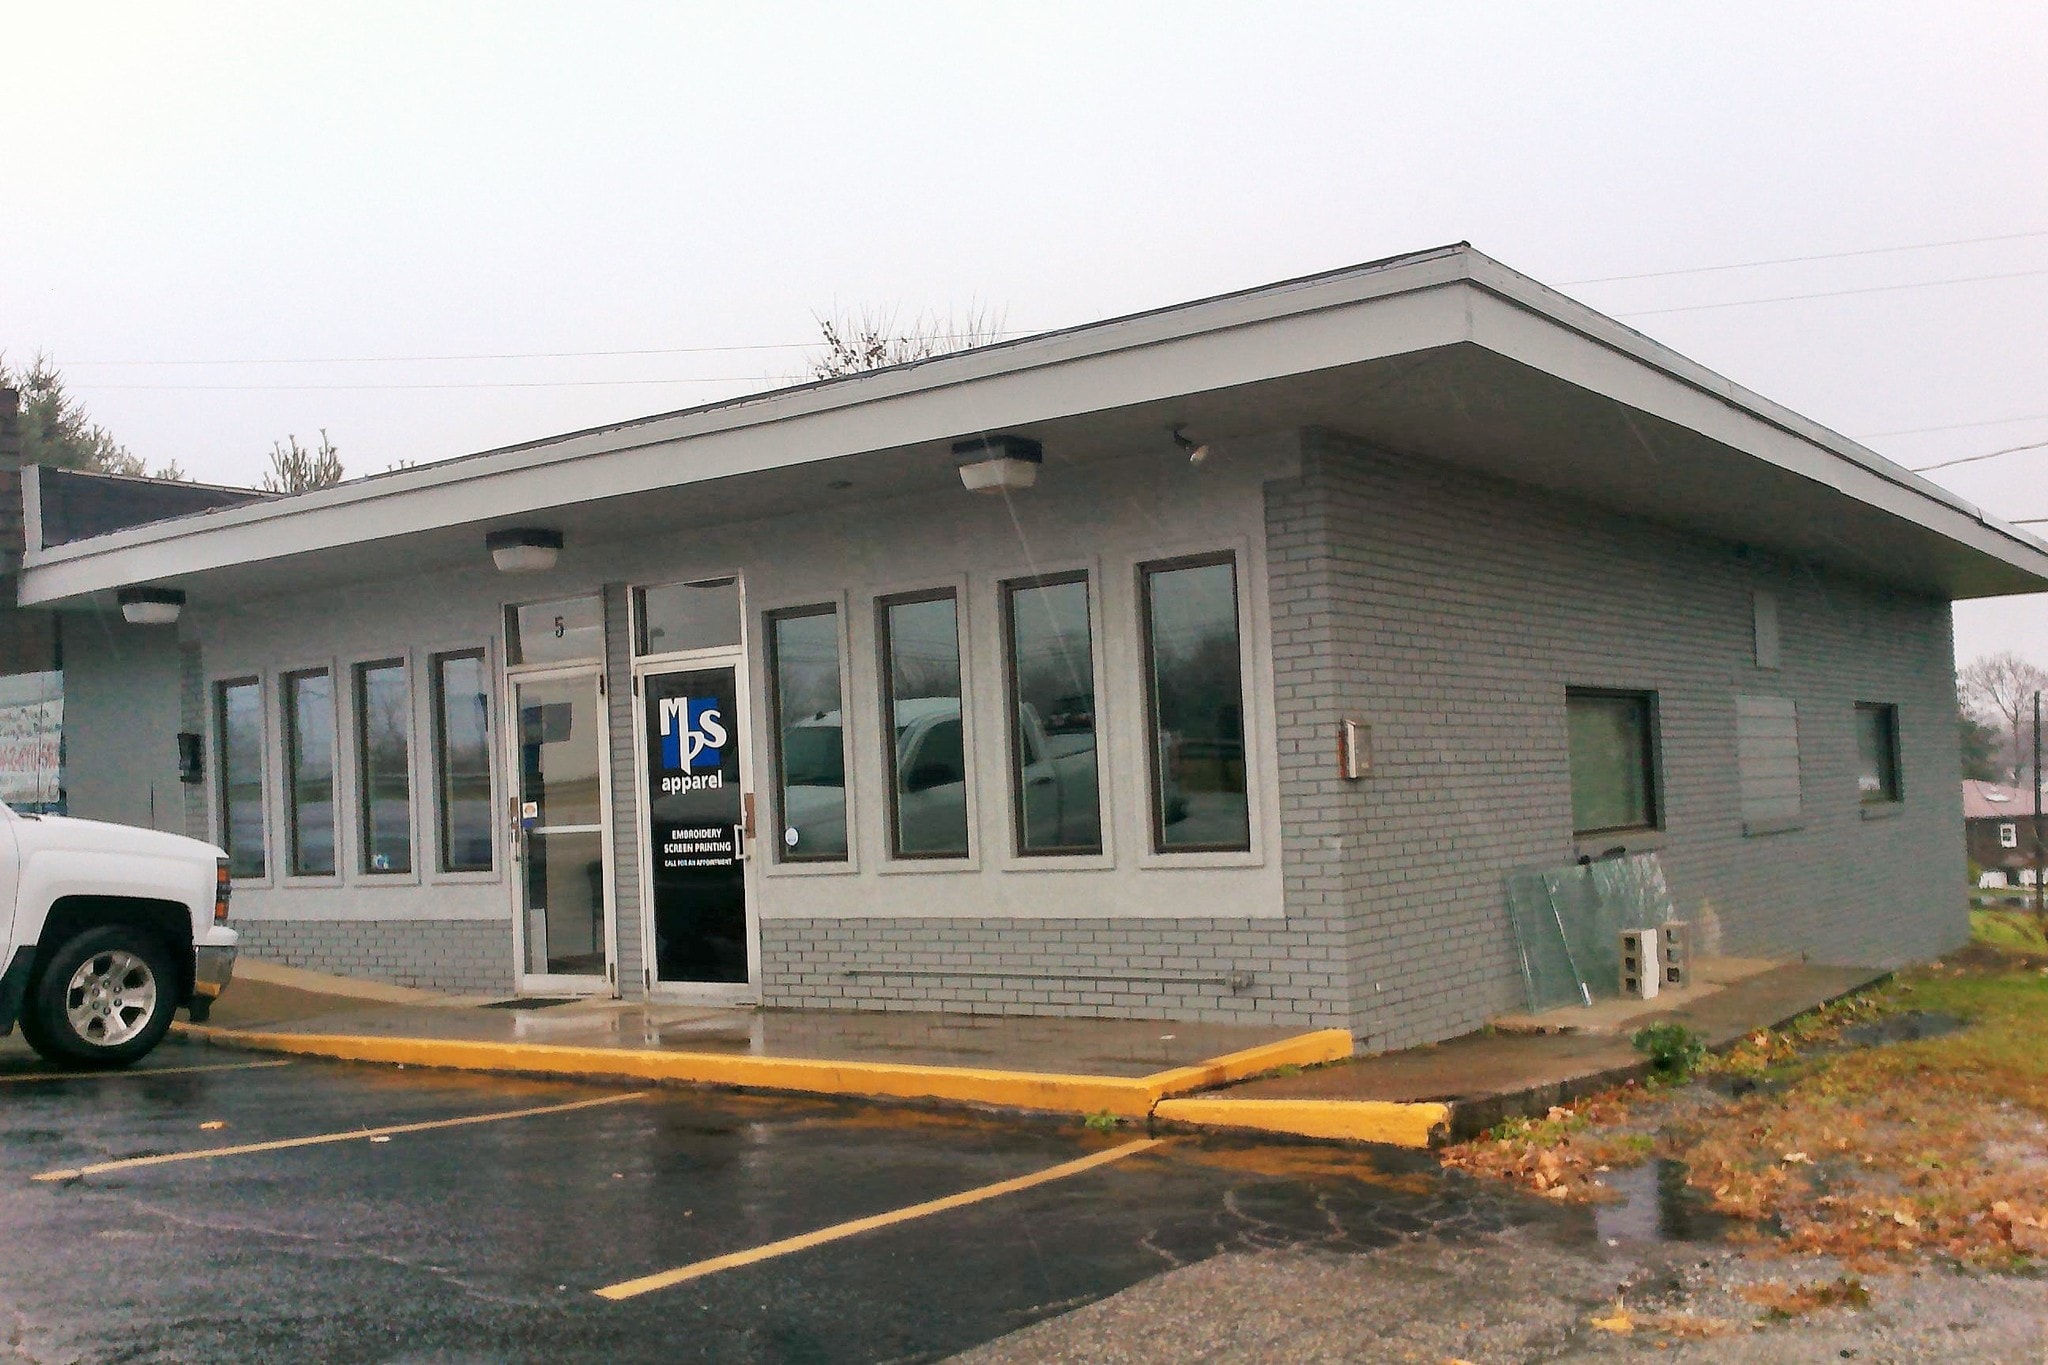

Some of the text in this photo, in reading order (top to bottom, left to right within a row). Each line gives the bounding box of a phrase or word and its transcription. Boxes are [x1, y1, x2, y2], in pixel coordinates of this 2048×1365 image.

[555, 616, 564, 638] 5
[662, 770, 723, 794] apparel
[672, 828, 722, 840] EMBROIDERY
[664, 841, 731, 854] SCREEN PRINTING
[665, 859, 677, 867] CALL
